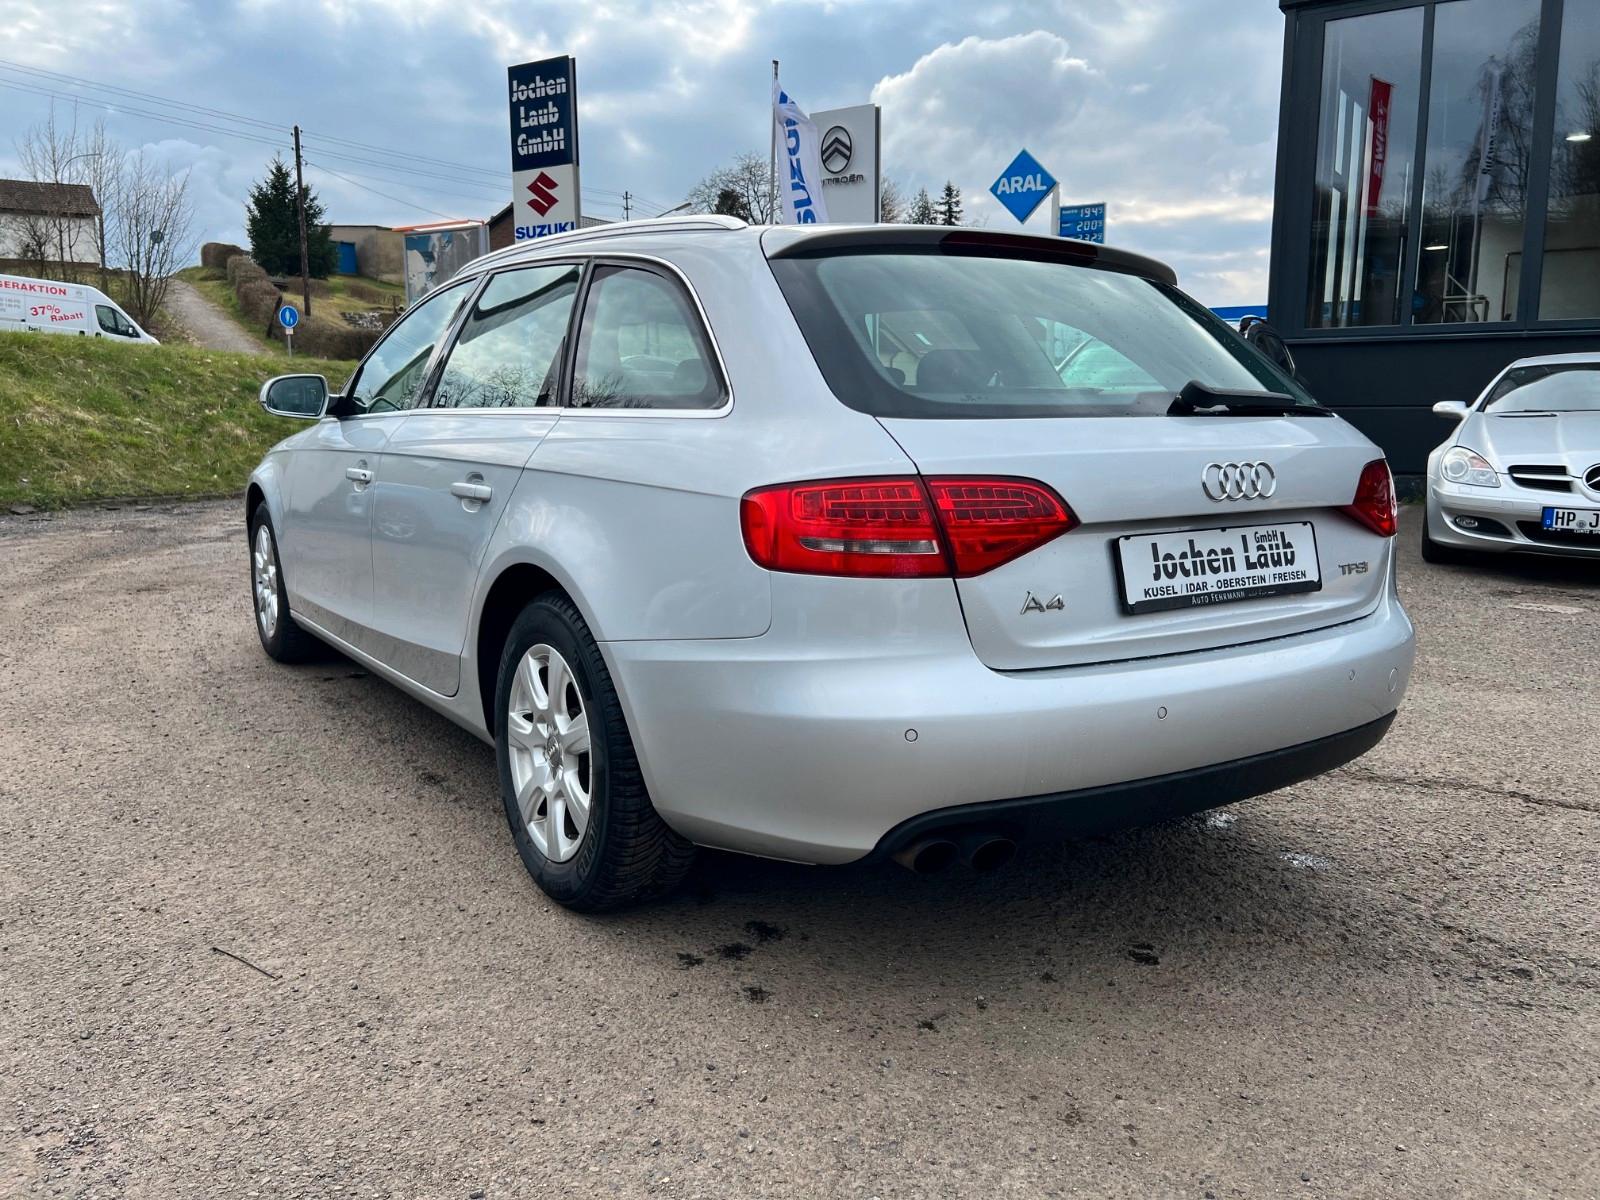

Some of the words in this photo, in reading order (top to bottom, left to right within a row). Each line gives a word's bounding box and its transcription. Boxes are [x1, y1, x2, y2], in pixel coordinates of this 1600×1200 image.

[512, 76, 567, 102] Jochen
[520, 102, 559, 128] Laub
[517, 128, 565, 156] GmbH
[822, 173, 864, 185] ITROËN
[997, 174, 1047, 195] ARAL
[516, 221, 575, 239] SUZUKI
[30, 304, 61, 317] 37%
[50, 312, 84, 322] Rabatt
[1555, 511, 1576, 526] HP
[1254, 530, 1278, 544] GmbH
[1151, 539, 1236, 581] Jochen
[1241, 532, 1296, 570] Laub
[1144, 586, 1178, 598] KUSEL
[1186, 582, 1208, 593] IDAR
[1216, 575, 1266, 588] OBERSTEIN
[1273, 570, 1306, 582] FREISEN
[1020, 591, 1065, 615] A4
